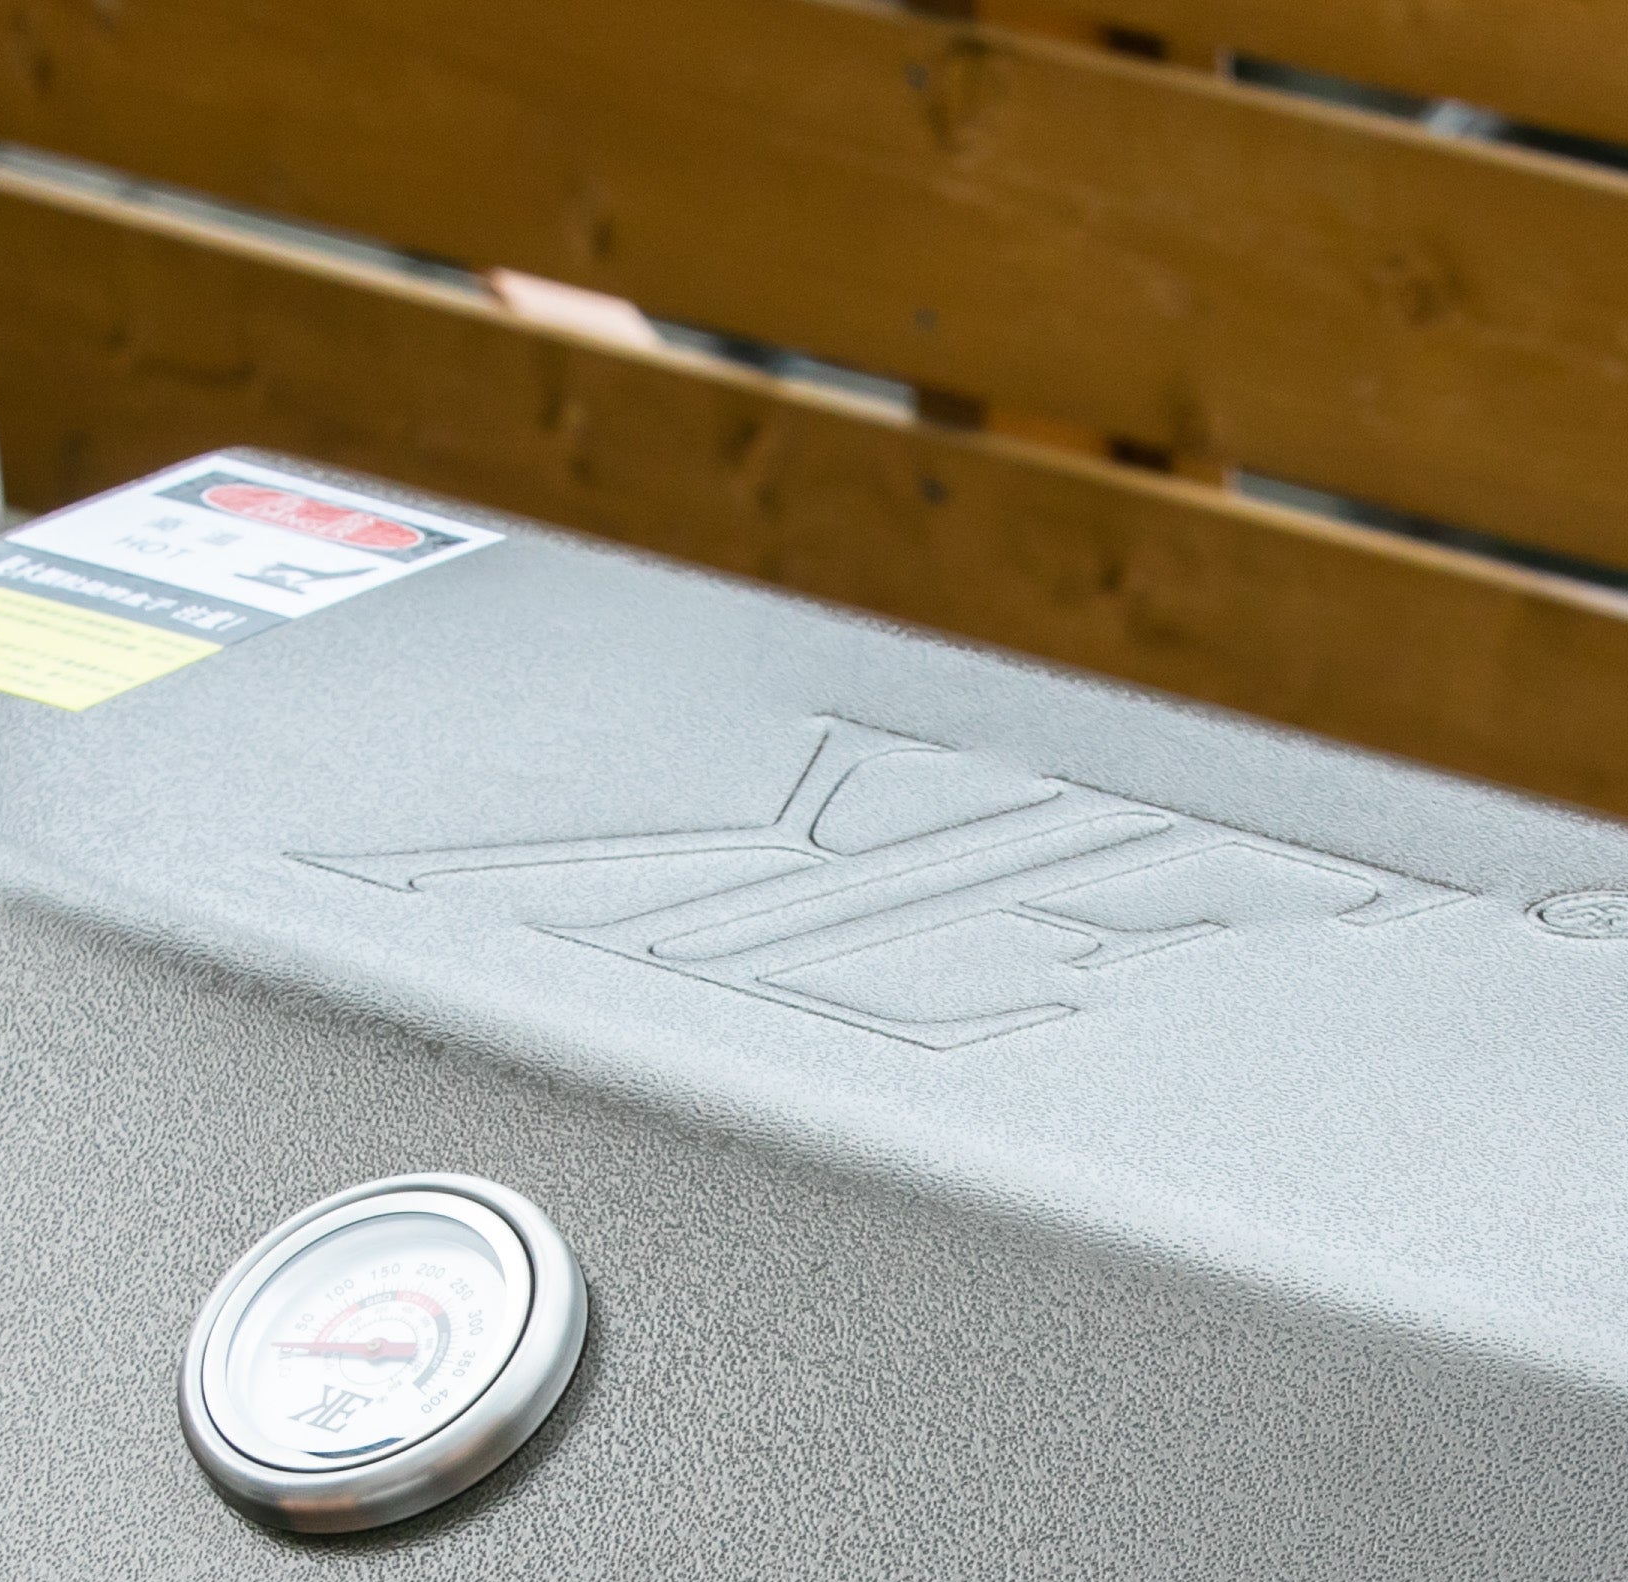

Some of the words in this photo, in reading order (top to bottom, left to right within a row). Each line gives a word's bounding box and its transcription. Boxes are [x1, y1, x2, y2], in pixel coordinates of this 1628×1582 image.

[371, 1262, 401, 1280] 150
[415, 1262, 445, 1280] 200
[325, 1278, 355, 1301] 100
[449, 1277, 473, 1301] 250
[295, 1312, 315, 1332] 50
[468, 1309, 484, 1336] 300
[452, 1351, 476, 1378] 350
[421, 1388, 449, 1414] 400
